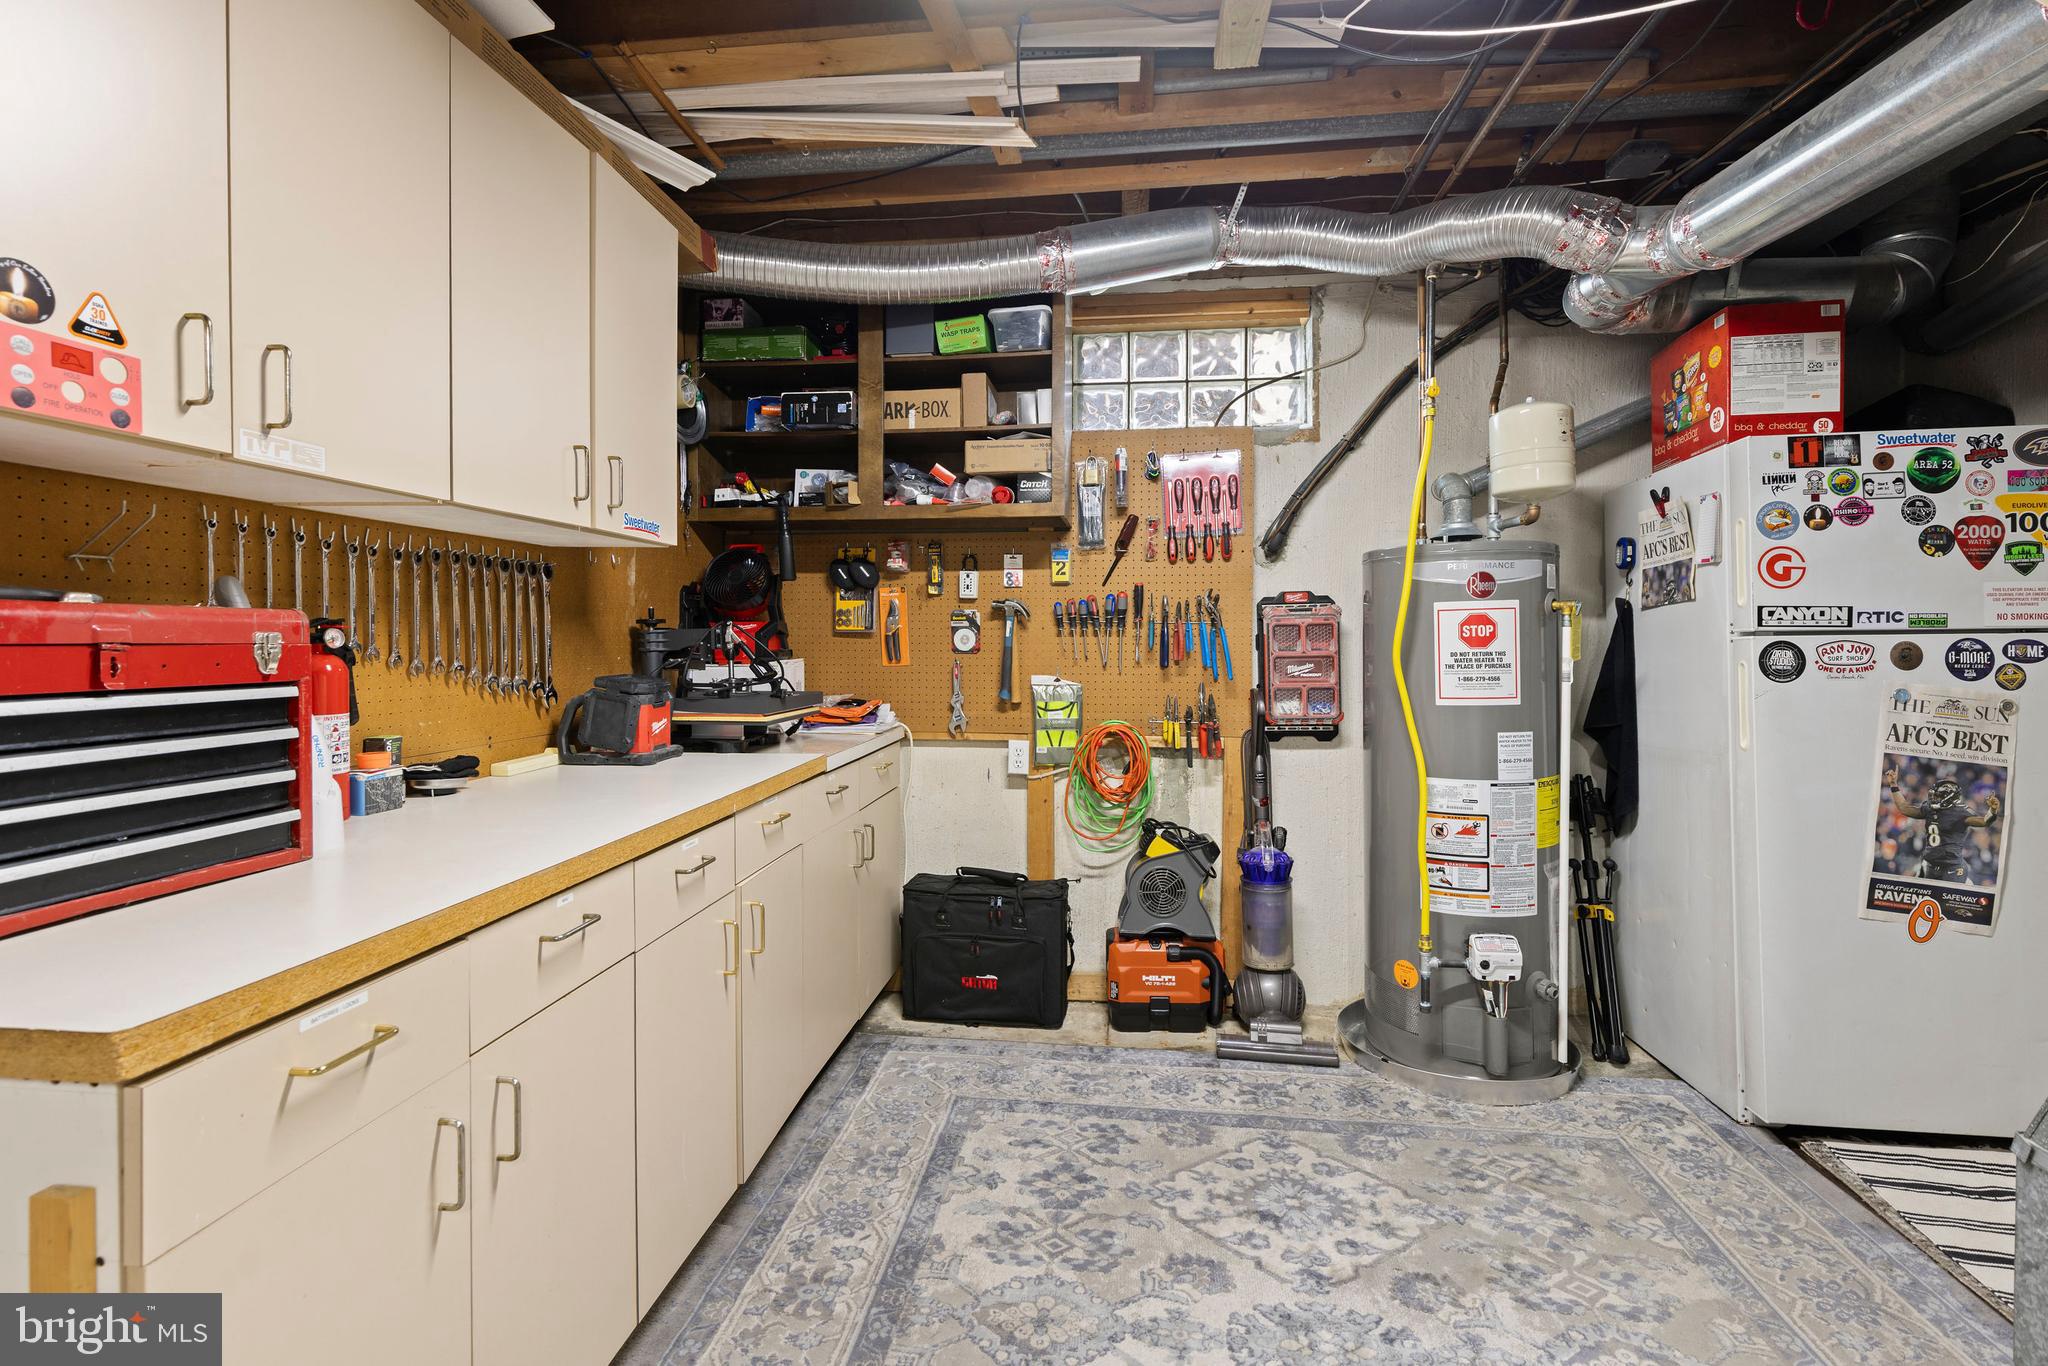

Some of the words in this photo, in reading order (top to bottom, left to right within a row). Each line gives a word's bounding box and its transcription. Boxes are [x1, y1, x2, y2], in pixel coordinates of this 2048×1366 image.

[91, 307, 105, 321] 30
[941, 330, 958, 338] WASP
[960, 327, 980, 335] TRAPS
[13, 369, 32, 379] OPEN
[63, 372, 81, 380] HOLD
[42, 381, 57, 391] OFF
[43, 399, 60, 410] FIRE
[64, 400, 104, 417] OPERATION
[1713, 410, 1720, 424] 50
[1734, 421, 1753, 431] bbq
[1757, 422, 1765, 430] &
[1769, 421, 1807, 430] cheddar
[1655, 445, 1666, 456] bbq
[1667, 440, 1673, 448] &
[1674, 428, 1698, 447] cheddar
[1877, 432, 1956, 445] Sweetwater
[1801, 441, 1809, 463] 1
[1914, 460, 1938, 469] AREA
[1942, 460, 1953, 469] 52
[1020, 480, 1048, 488] CATCH
[1762, 474, 1796, 485] LINKIN
[624, 513, 660, 533] Sweetwater
[1640, 520, 1657, 534] THE
[1957, 525, 2002, 538] 2000
[1669, 531, 1690, 553] BEST
[1055, 561, 1066, 576] 2
[1447, 562, 1515, 570] PERFMANCE
[1470, 571, 1495, 595] Rheem
[1762, 606, 1849, 620] CANYON
[1857, 611, 1904, 623] RTIC
[1462, 625, 1494, 638] STOP
[1821, 644, 1844, 657] RON
[1847, 645, 1870, 655] JON
[1948, 651, 1991, 664] B-MORE
[1818, 665, 1834, 673] ONE
[1855, 665, 1874, 673] KIND
[1889, 697, 1931, 714] THE
[1886, 723, 1948, 748] AFC'S
[1952, 730, 2009, 755] BEST
[1950, 751, 1967, 760] seed,
[1980, 754, 2008, 764] division
[1928, 824, 1940, 847] 8
[1876, 883, 1932, 895] CONGRATULATIONS
[1942, 893, 1977, 903] SAFEWAY
